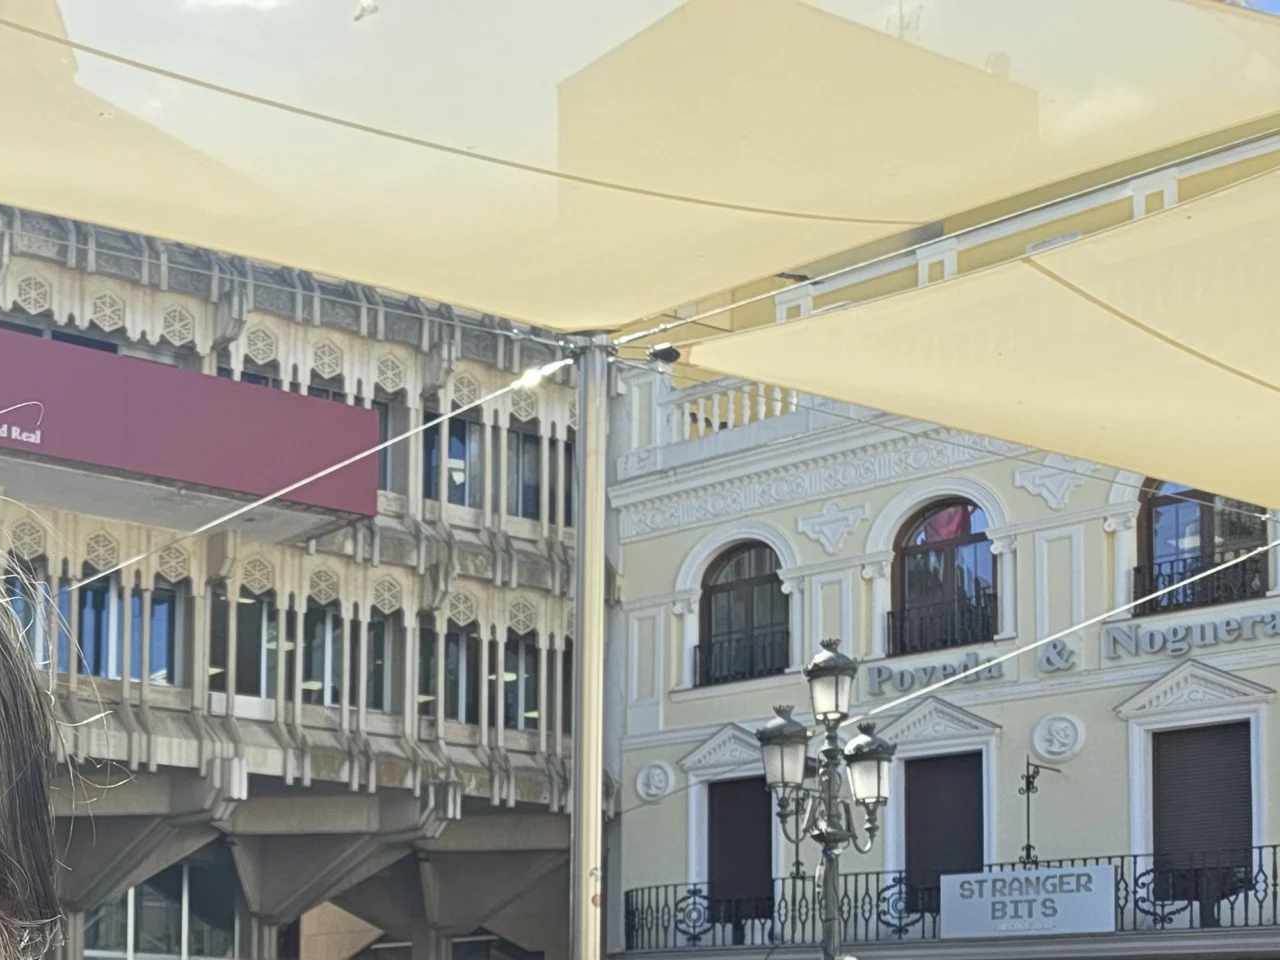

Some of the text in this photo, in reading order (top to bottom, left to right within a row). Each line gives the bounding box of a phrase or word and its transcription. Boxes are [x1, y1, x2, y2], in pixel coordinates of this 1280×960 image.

[10, 426, 42, 444] Real
[868, 610, 1280, 696] Poveda & Noguera
[959, 873, 1093, 899] STRANGER
[991, 898, 1058, 920] BITS
